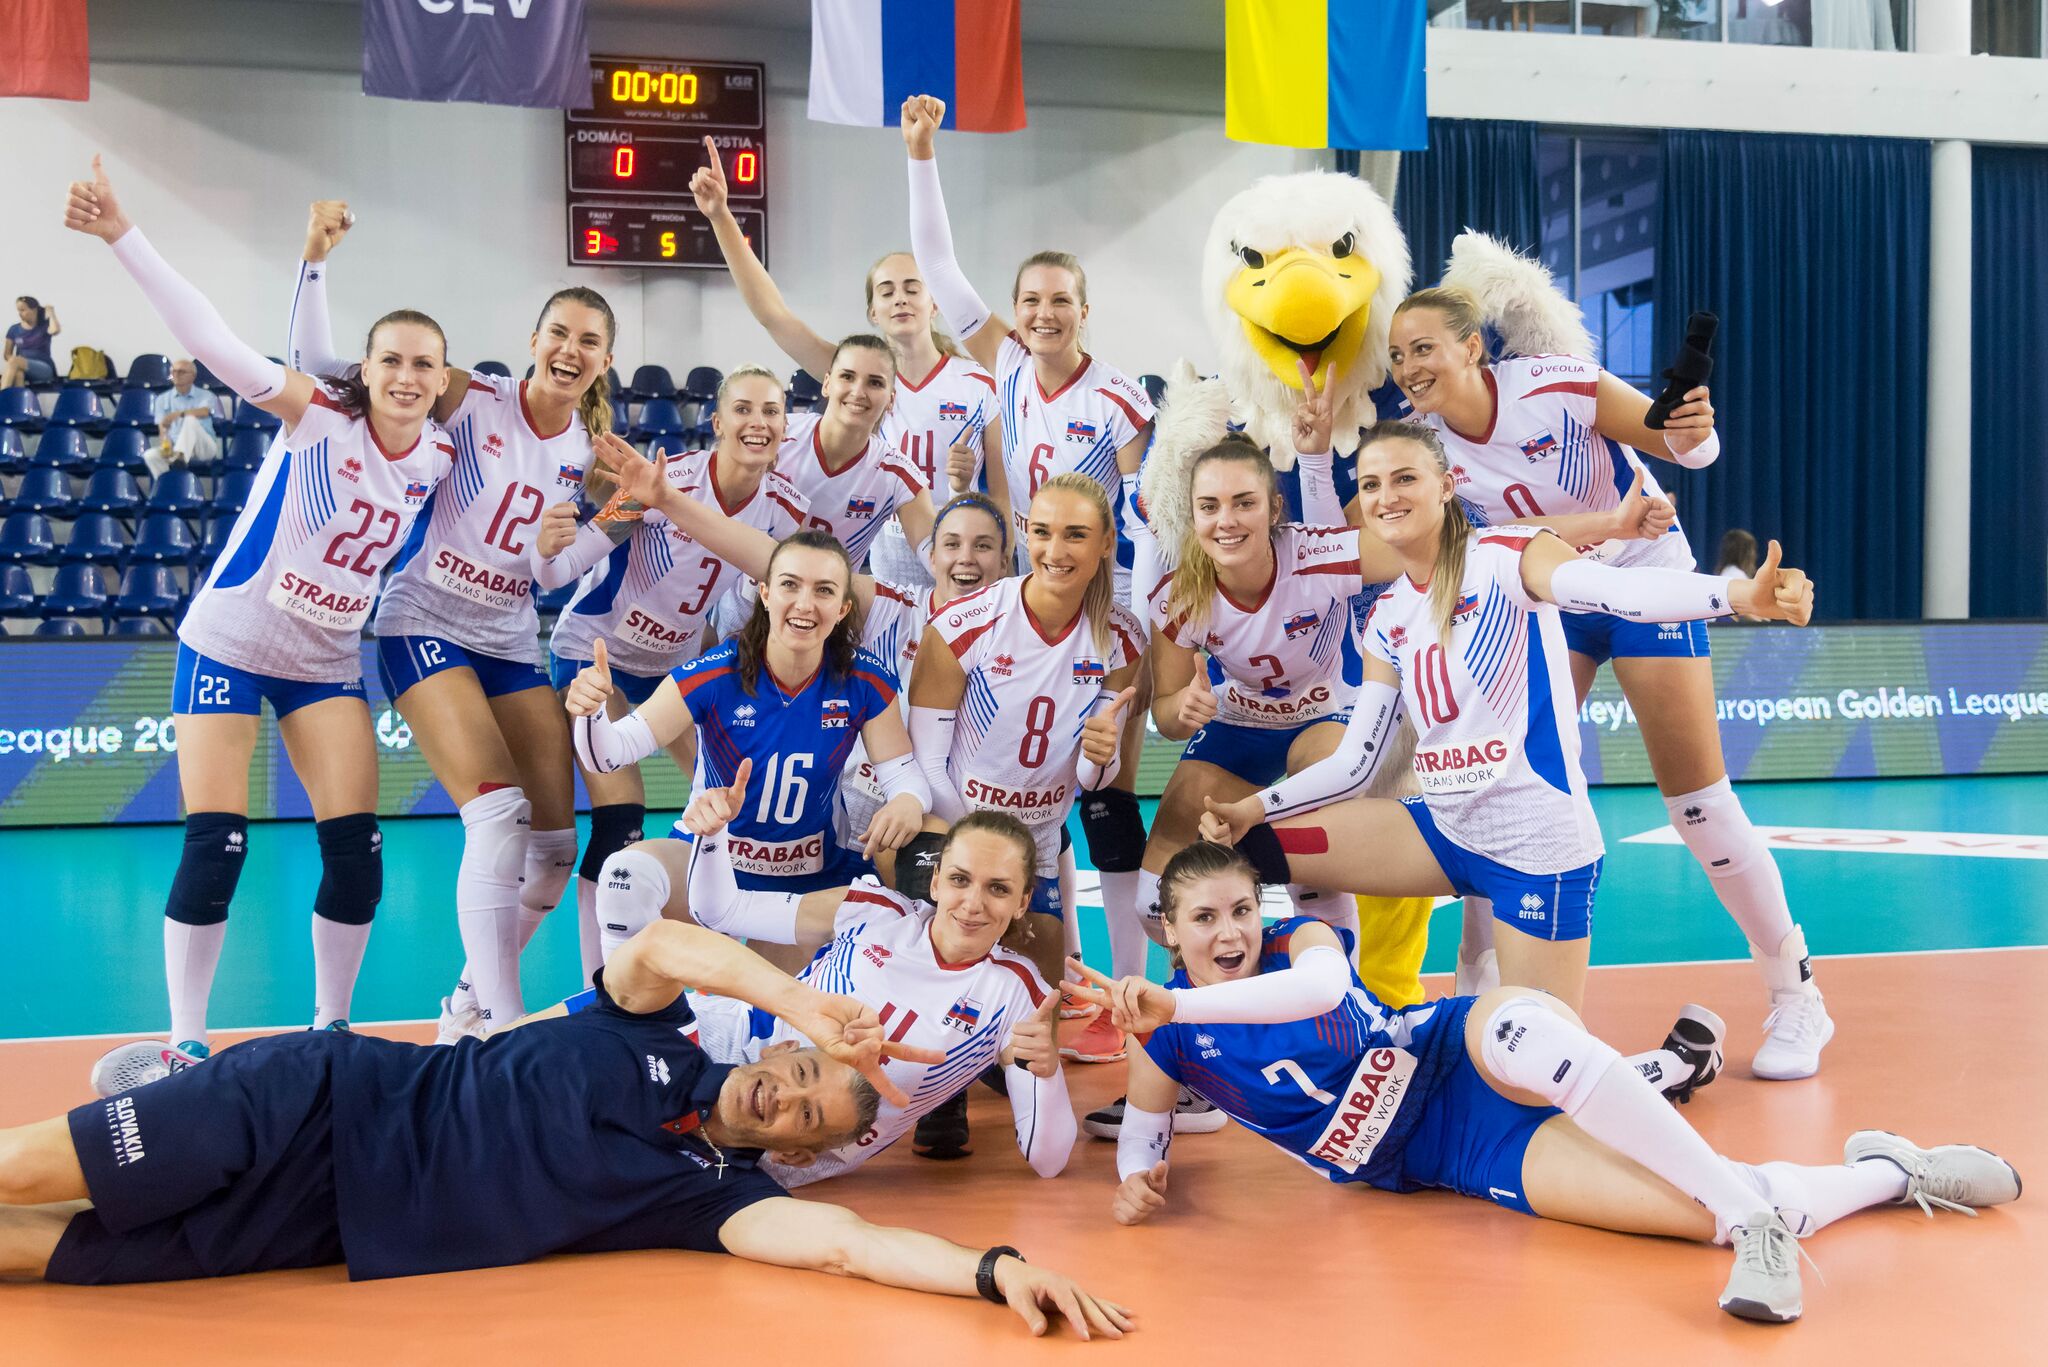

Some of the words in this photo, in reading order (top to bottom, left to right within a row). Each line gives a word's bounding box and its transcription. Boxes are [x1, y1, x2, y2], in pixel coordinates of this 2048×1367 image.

[724, 74, 754, 89] LGR
[576, 129, 633, 144] DOMÁCI
[615, 147, 634, 177] 0
[737, 153, 756, 182] 0
[659, 231, 677, 258] 5
[1545, 364, 1585, 374] VEOLIA
[1122, 381, 1149, 408] VEOLIA
[667, 467, 694, 481] EOLIA
[484, 480, 546, 556] 12
[322, 498, 401, 577] 22
[1307, 544, 1344, 556] VEOLIA
[435, 550, 530, 598] STRABAG
[441, 574, 480, 600] TEAMS
[678, 556, 722, 616] 3
[285, 596, 325, 621] TEAMS
[418, 640, 447, 669] 12
[631, 632, 666, 651] TEAMS
[697, 648, 734, 664] VEOLIA
[854, 652, 892, 678] VEOLIA
[1248, 654, 1291, 698] 2
[198, 674, 231, 705] 22
[1227, 686, 1330, 715] STRABAG
[1414, 642, 1460, 730] 10
[1239, 706, 1278, 722] TEAMS
[1716, 694, 1832, 727] uropean
[1837, 686, 1944, 720] Golden
[0, 726, 123, 764] eague
[134, 716, 178, 752] 20
[1018, 696, 1056, 769] 8
[1414, 740, 1508, 772] STRABAG
[756, 752, 814, 826] 16
[867, 782, 886, 798] TEA
[964, 778, 1066, 809] STRABAG
[728, 838, 822, 864] TRABAG
[1260, 1058, 1337, 1106] 7
[1314, 1048, 1396, 1162] STRABAG
[105, 1102, 128, 1168] VOLLEYBALL
[116, 1096, 145, 1164] SLOVAKIA
[1347, 1125, 1380, 1164] EAMS
